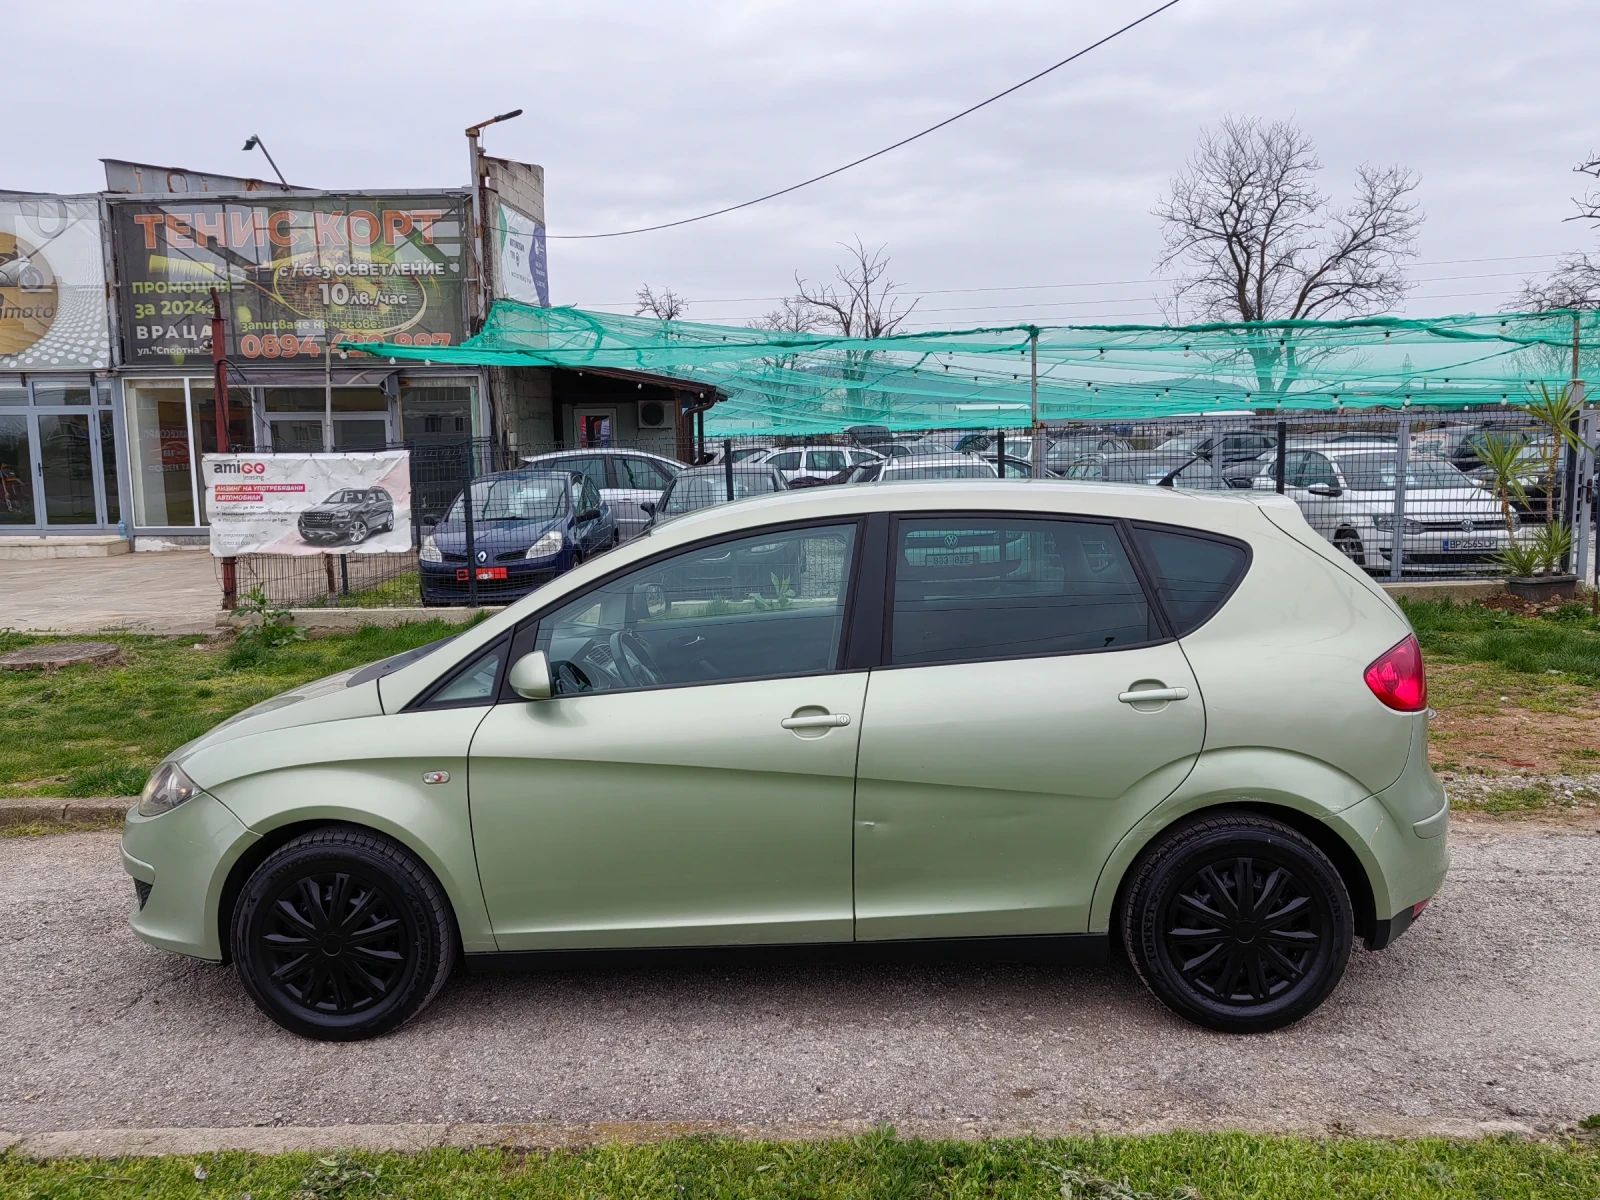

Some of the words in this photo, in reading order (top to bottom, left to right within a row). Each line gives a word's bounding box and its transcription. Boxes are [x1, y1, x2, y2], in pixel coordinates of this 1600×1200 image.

[134, 211, 299, 249] ТЕНИС
[312, 209, 442, 246] КОРТ
[302, 262, 331, 279] без
[334, 262, 445, 277] ОСВЕТЛЕНИЕ
[131, 280, 231, 296] ПРОМОЦИЯ
[134, 303, 156, 319] за
[136, 325, 213, 341] ВРАЦА
[241, 319, 310, 332] записване
[313, 320, 329, 330] на
[332, 318, 382, 330] часове:
[240, 333, 321, 359] 0894
[243, 474, 265, 482] leasing
[1144, 908, 1157, 962] TOMKET
